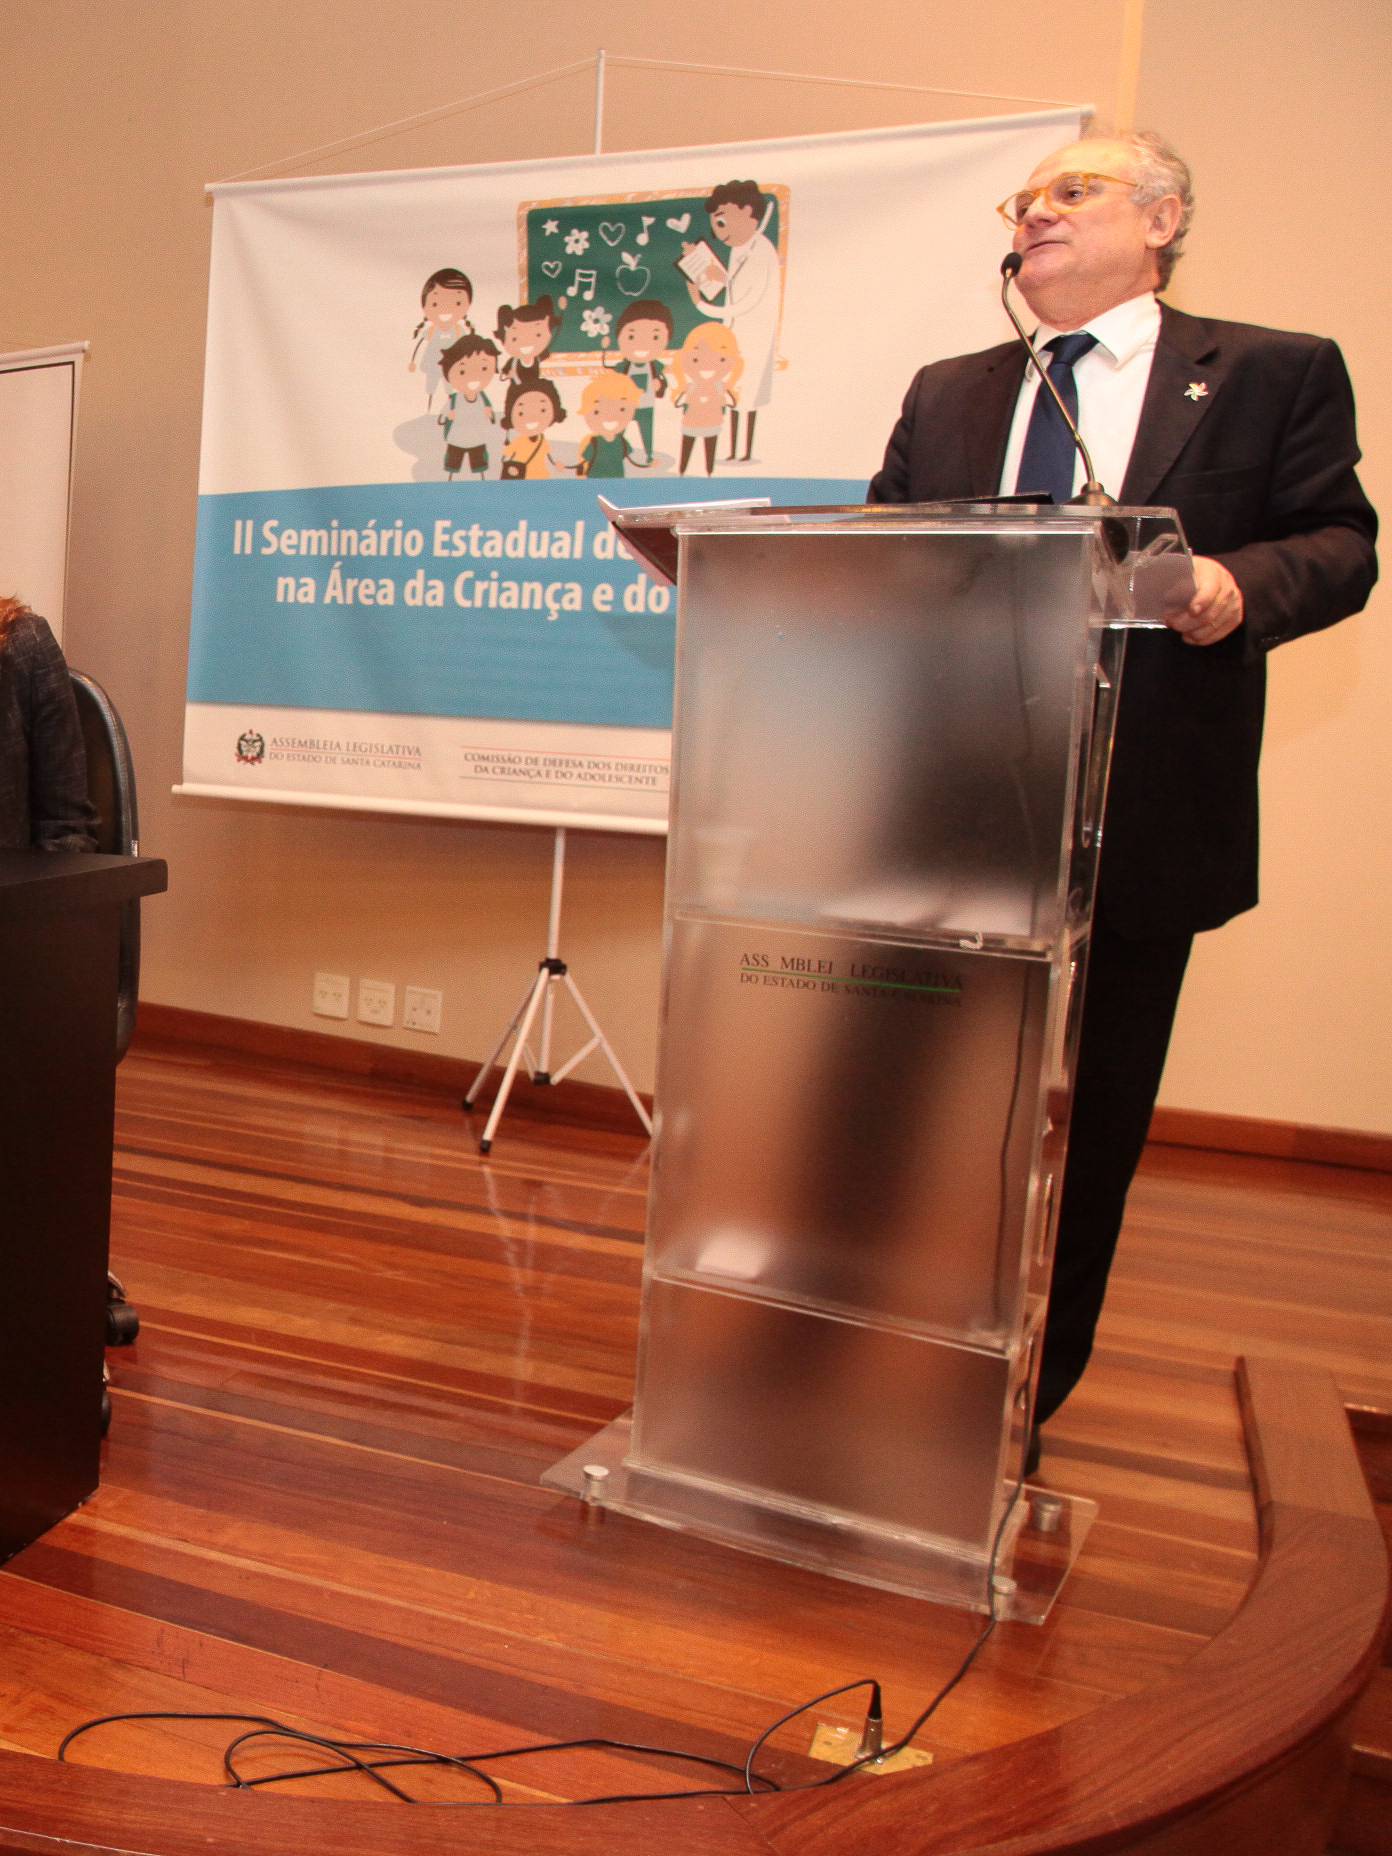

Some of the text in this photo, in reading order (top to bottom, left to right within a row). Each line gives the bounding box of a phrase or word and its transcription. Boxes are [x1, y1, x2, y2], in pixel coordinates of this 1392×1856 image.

[233, 519, 253, 555] II
[261, 519, 424, 556] Seminário
[433, 520, 585, 560] Estadual
[276, 561, 670, 620] na Área da Criança e do
[271, 737, 421, 757] ASSEMBLEIA LEGISLATIVA
[268, 752, 421, 770] DO ESTADO DE SANTA CATARINA
[525, 756, 538, 766] DE
[543, 757, 584, 769] DEFESA
[587, 760, 611, 771] DOS
[474, 764, 489, 774] DA
[555, 769, 573, 779] DO
[576, 771, 657, 786] ADOLESCENTE
[740, 972, 758, 984] DO
[763, 974, 816, 991] ESTADO
[821, 981, 838, 994] DE
